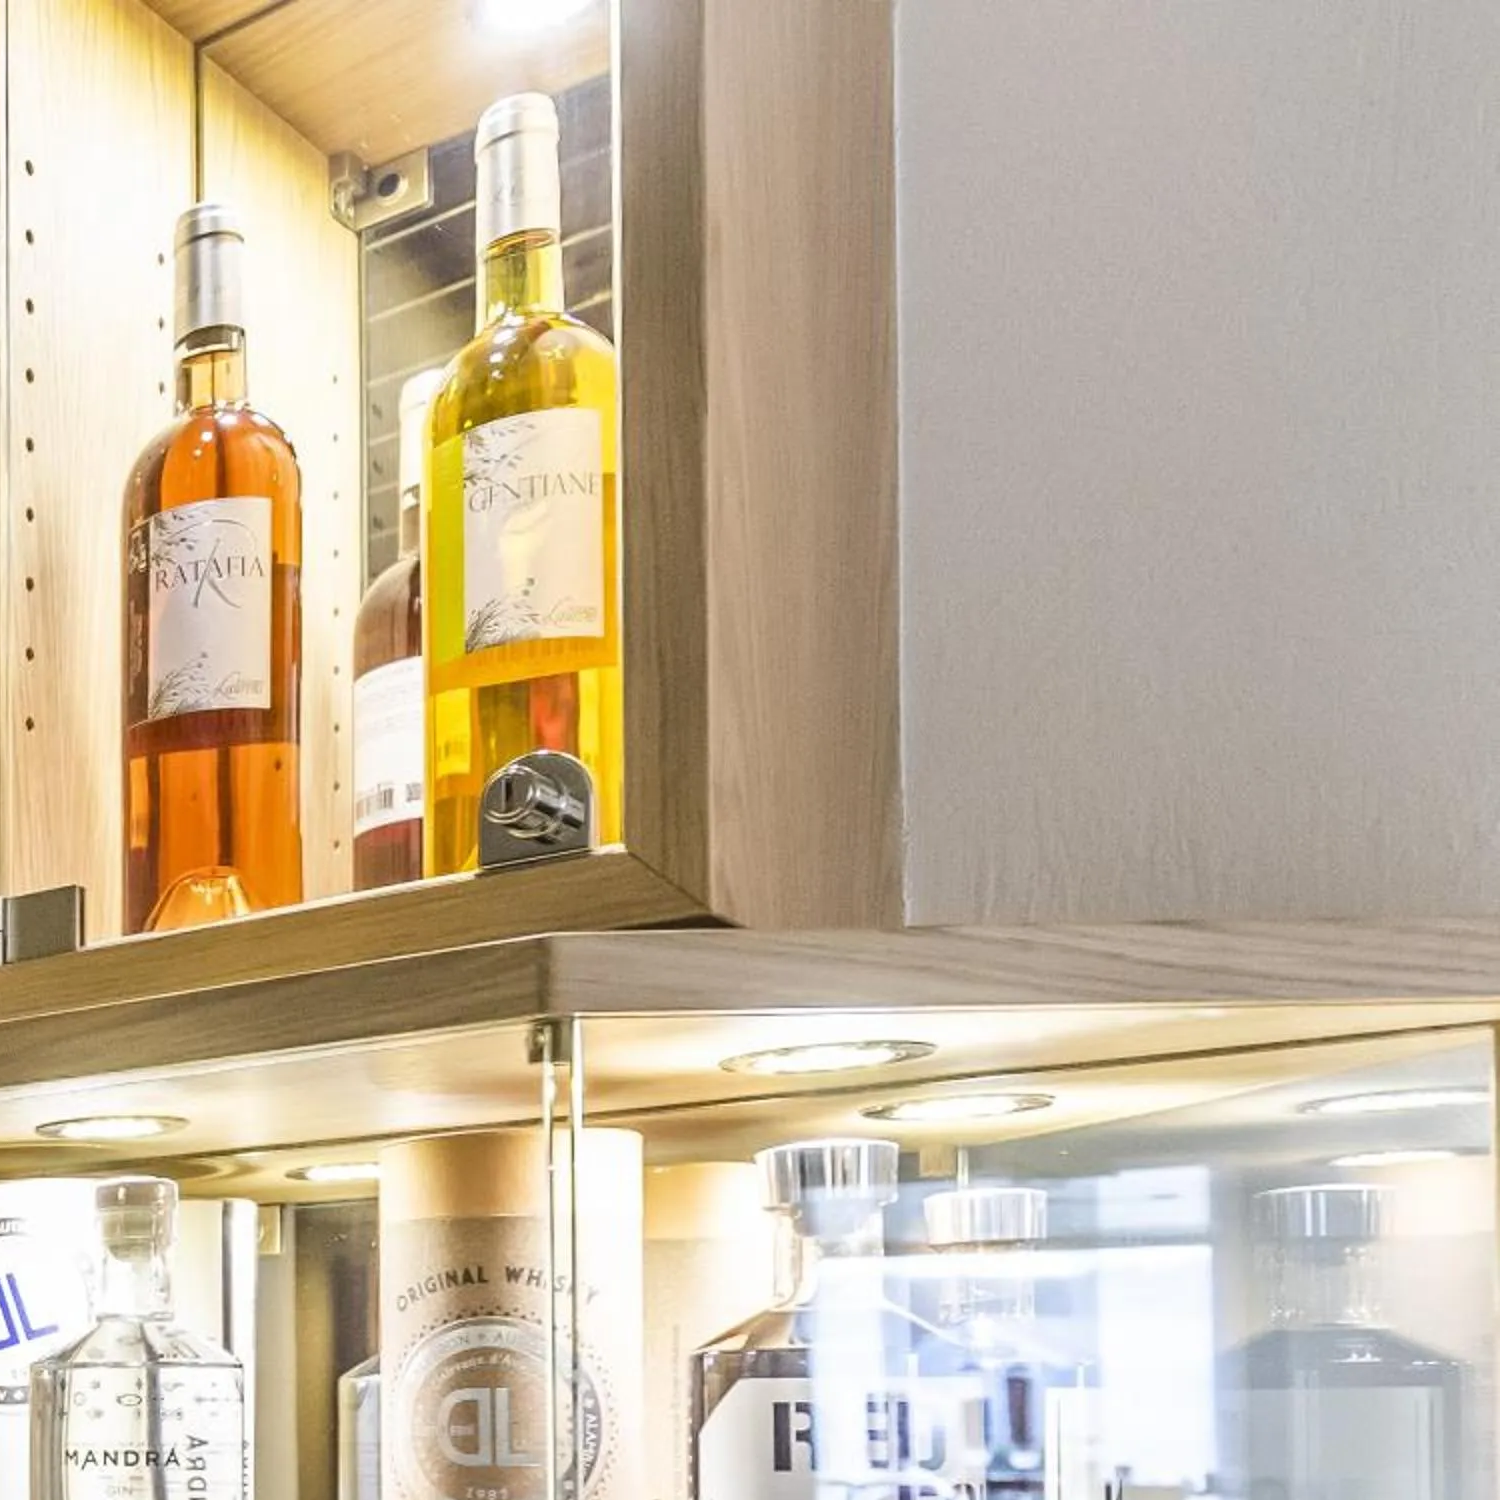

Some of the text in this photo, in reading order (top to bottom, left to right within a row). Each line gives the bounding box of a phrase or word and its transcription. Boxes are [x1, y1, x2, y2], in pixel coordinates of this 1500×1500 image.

[155, 555, 264, 593] RATAFIA
[396, 1266, 601, 1312] ORIGINAL WHISY
